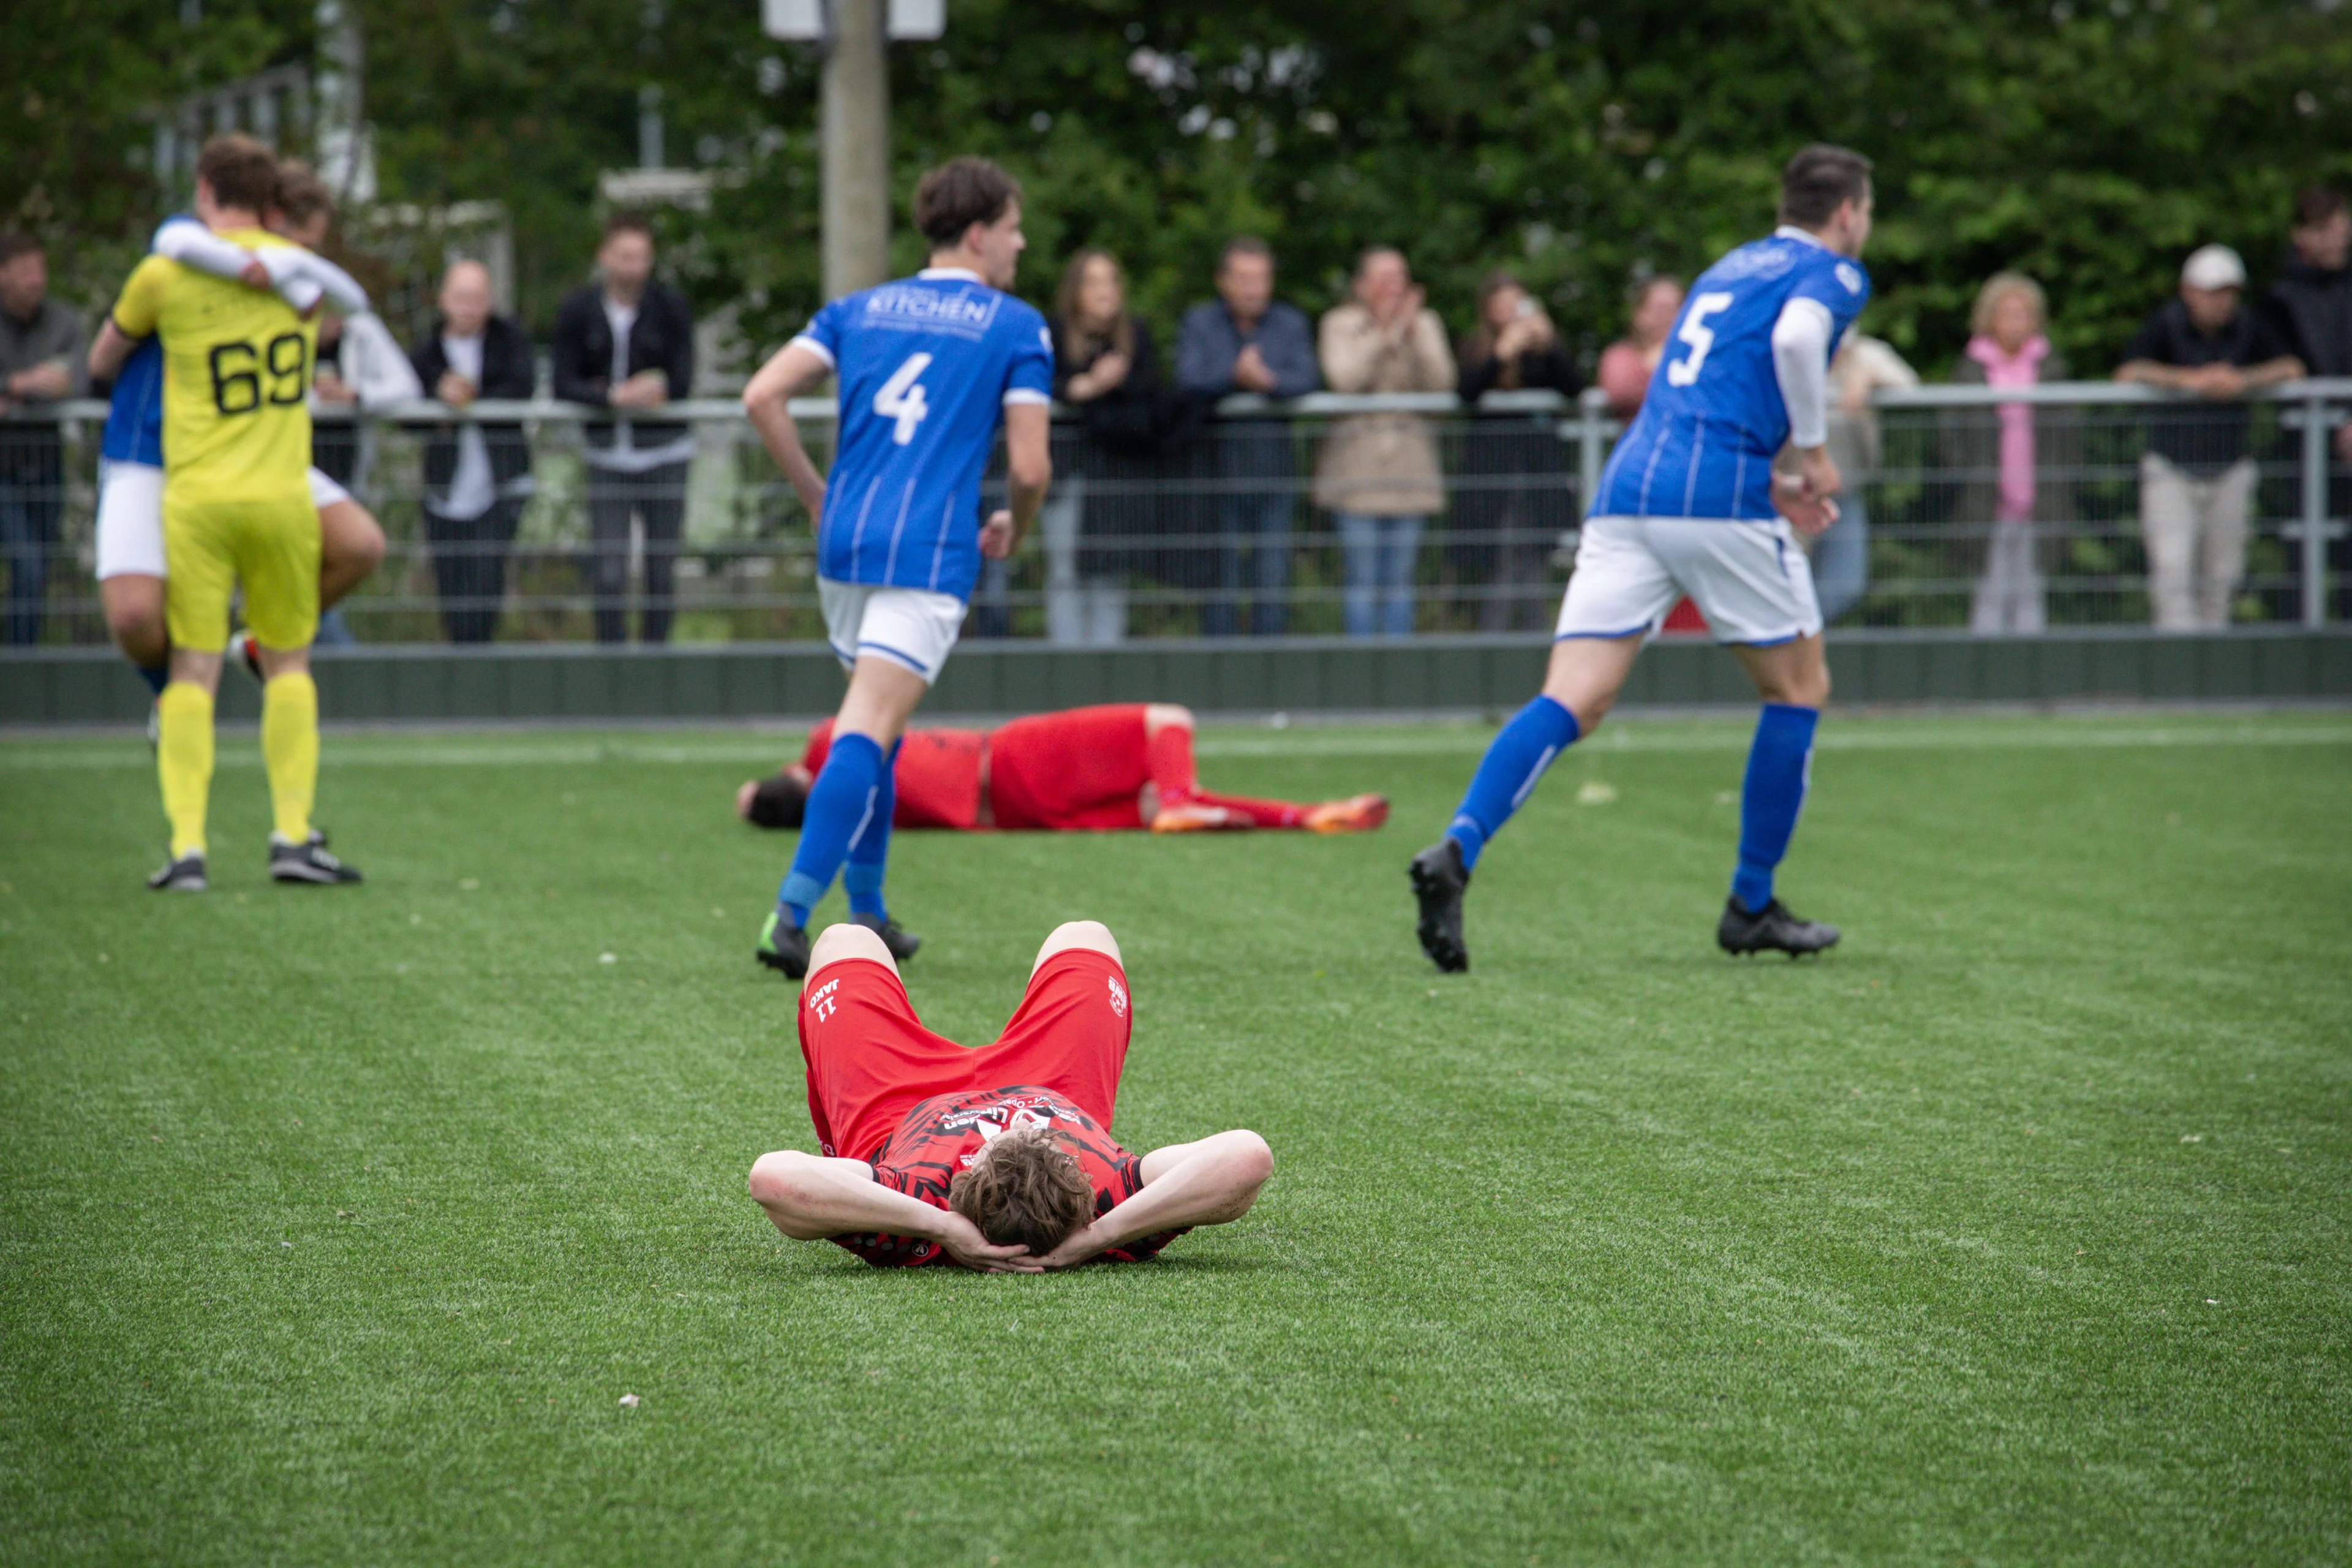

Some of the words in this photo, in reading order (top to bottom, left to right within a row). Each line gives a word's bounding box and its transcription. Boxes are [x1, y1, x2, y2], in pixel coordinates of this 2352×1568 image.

[866, 294, 987, 322] KITCHEN
[1667, 291, 1734, 387] 5
[209, 333, 306, 415] 69
[873, 352, 933, 445] 4
[810, 979, 839, 1008] JAKO
[816, 996, 836, 1023] 11
